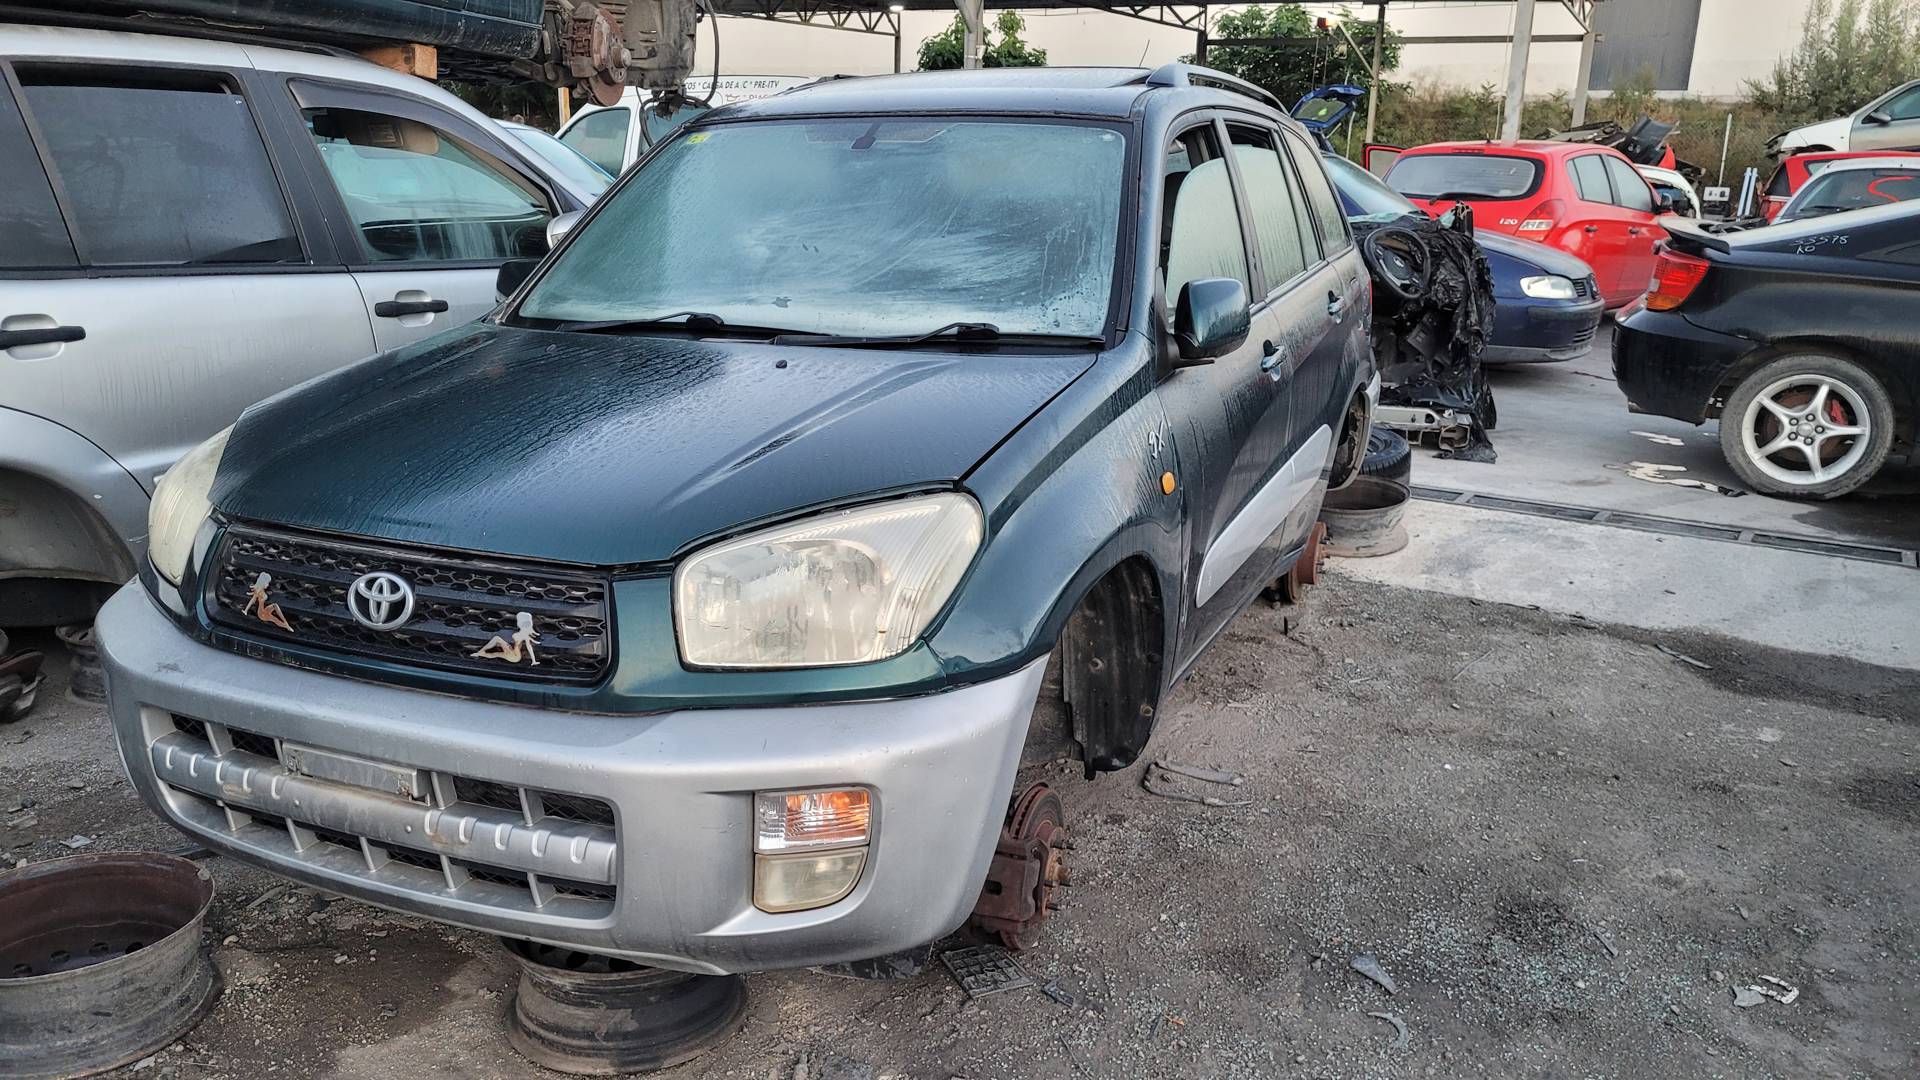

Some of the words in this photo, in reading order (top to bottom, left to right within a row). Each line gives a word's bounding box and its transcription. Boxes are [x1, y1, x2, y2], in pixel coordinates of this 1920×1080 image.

[686, 82, 696, 90] OS
[702, 81, 723, 90] CAGA
[725, 81, 734, 89] DE
